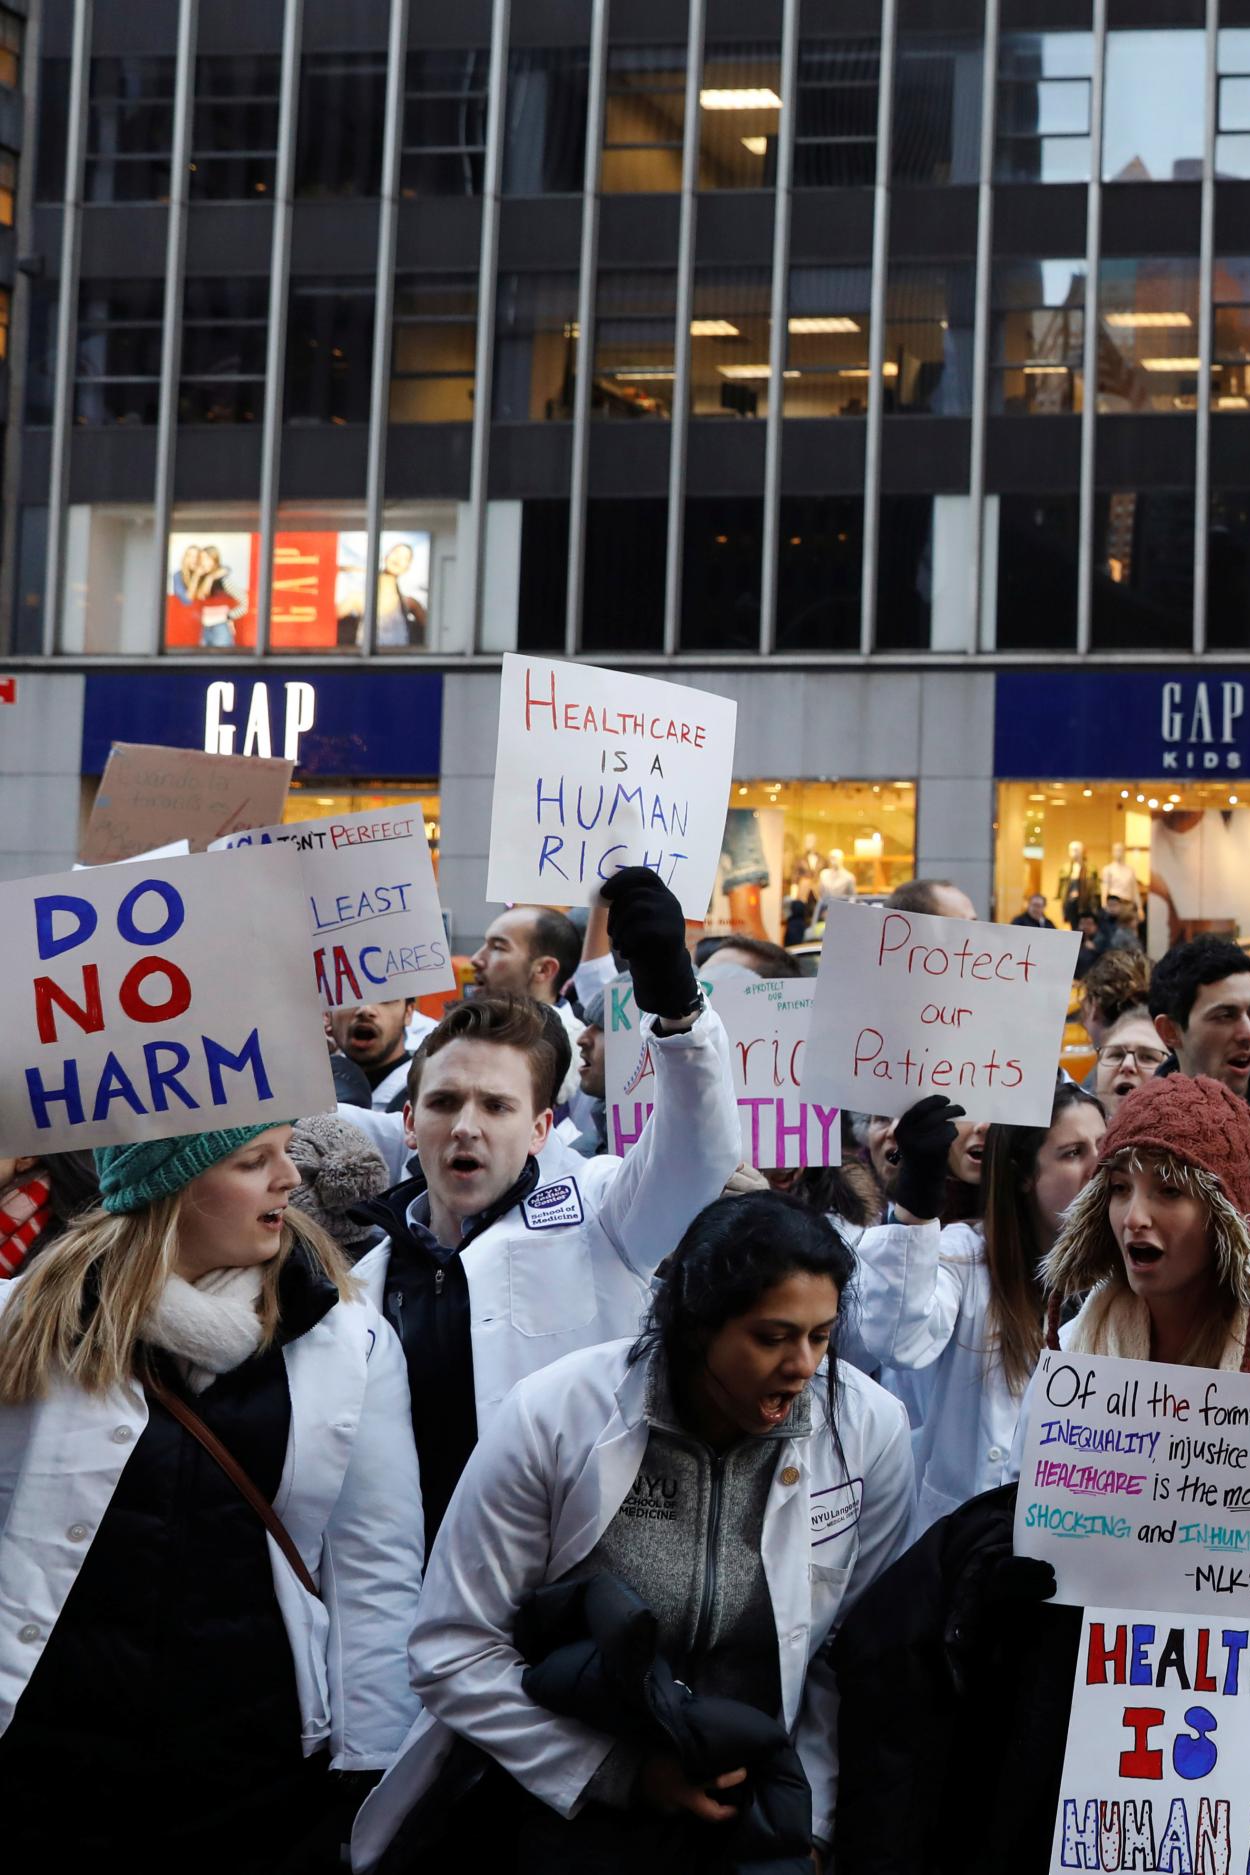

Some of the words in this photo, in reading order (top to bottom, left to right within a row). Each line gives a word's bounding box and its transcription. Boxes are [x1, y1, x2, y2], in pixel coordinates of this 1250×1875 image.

[204, 681, 315, 764] GAP
[1162, 681, 1244, 743] GAP
[601, 750, 628, 773] IS
[650, 754, 664, 779] A
[1162, 752, 1241, 769] KIDS
[537, 775, 688, 837] HUMAN
[330, 819, 415, 850] PERFECT
[539, 835, 688, 887] RIGHT
[33, 879, 185, 960] DO
[310, 884, 412, 929] LEAST
[879, 914, 1037, 982] Protect
[33, 955, 192, 1044] NO
[768, 992, 782, 1001] OUR
[920, 1004, 973, 1028] our
[25, 1027, 274, 1129] HARM
[854, 1028, 1023, 1087] Patients
[531, 1188, 569, 1205] Medical
[531, 1207, 564, 1220] School
[565, 1205, 576, 1213] of
[534, 1194, 567, 1208] Center
[536, 1187, 561, 1198] NYU
[532, 1213, 579, 1226] Medicine
[1106, 1380, 1139, 1418] all
[1147, 1382, 1190, 1422] the
[1168, 1434, 1249, 1469] injustice
[632, 1475, 678, 1499] NYU
[1034, 1460, 1147, 1495] HEALTHCARE
[1152, 1473, 1170, 1500] is
[1176, 1474, 1218, 1506] the
[619, 1506, 678, 1521] MEDICINE
[811, 1511, 830, 1525] NYU
[1025, 1503, 1131, 1538] SHOCKING
[1137, 1520, 1177, 1545] and
[1118, 1706, 1218, 1781] IS
[1060, 1798, 1231, 1875] HUMAN
